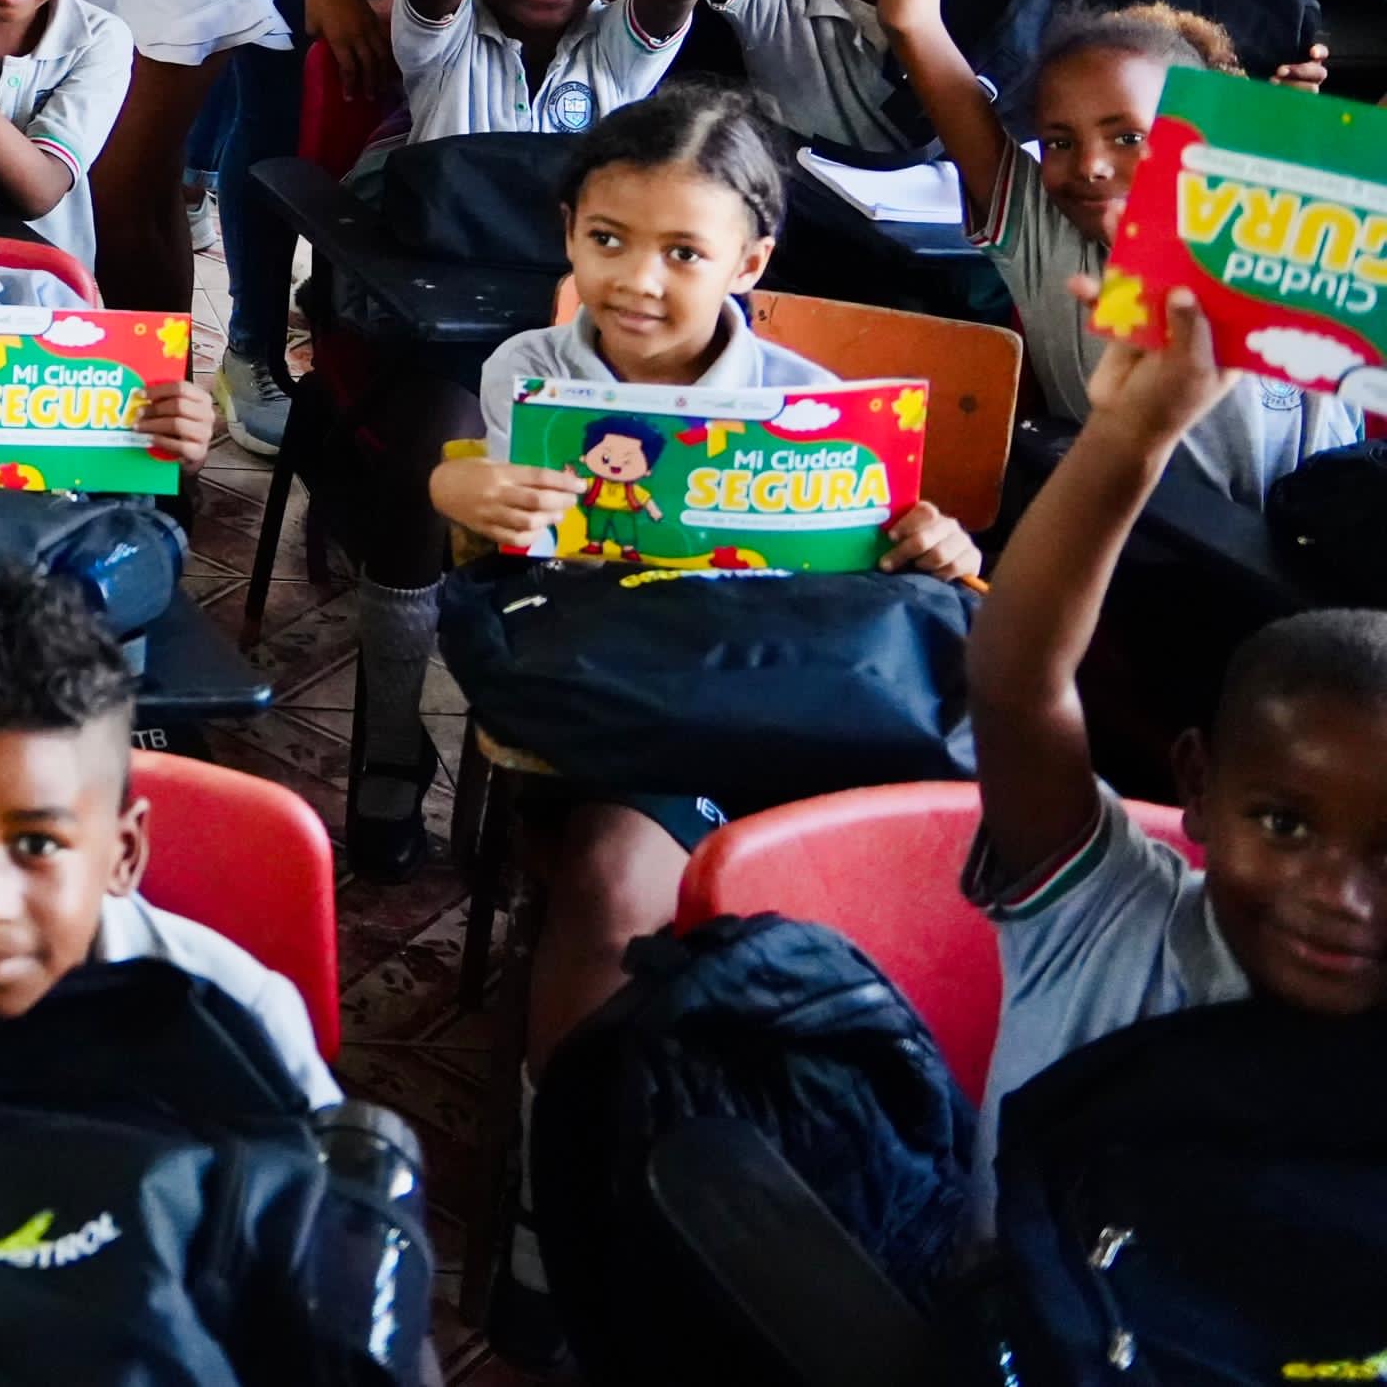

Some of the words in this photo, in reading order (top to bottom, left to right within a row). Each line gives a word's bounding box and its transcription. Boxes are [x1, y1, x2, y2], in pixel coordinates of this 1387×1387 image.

[1222, 251, 1379, 313] Ciudad
[11, 364, 39, 384] Mi
[43, 365, 123, 386] Ciudad
[733, 450, 763, 470] Mi
[770, 445, 859, 471] Ciudad
[684, 463, 891, 513] SEGURA
[131, 729, 168, 750] TB
